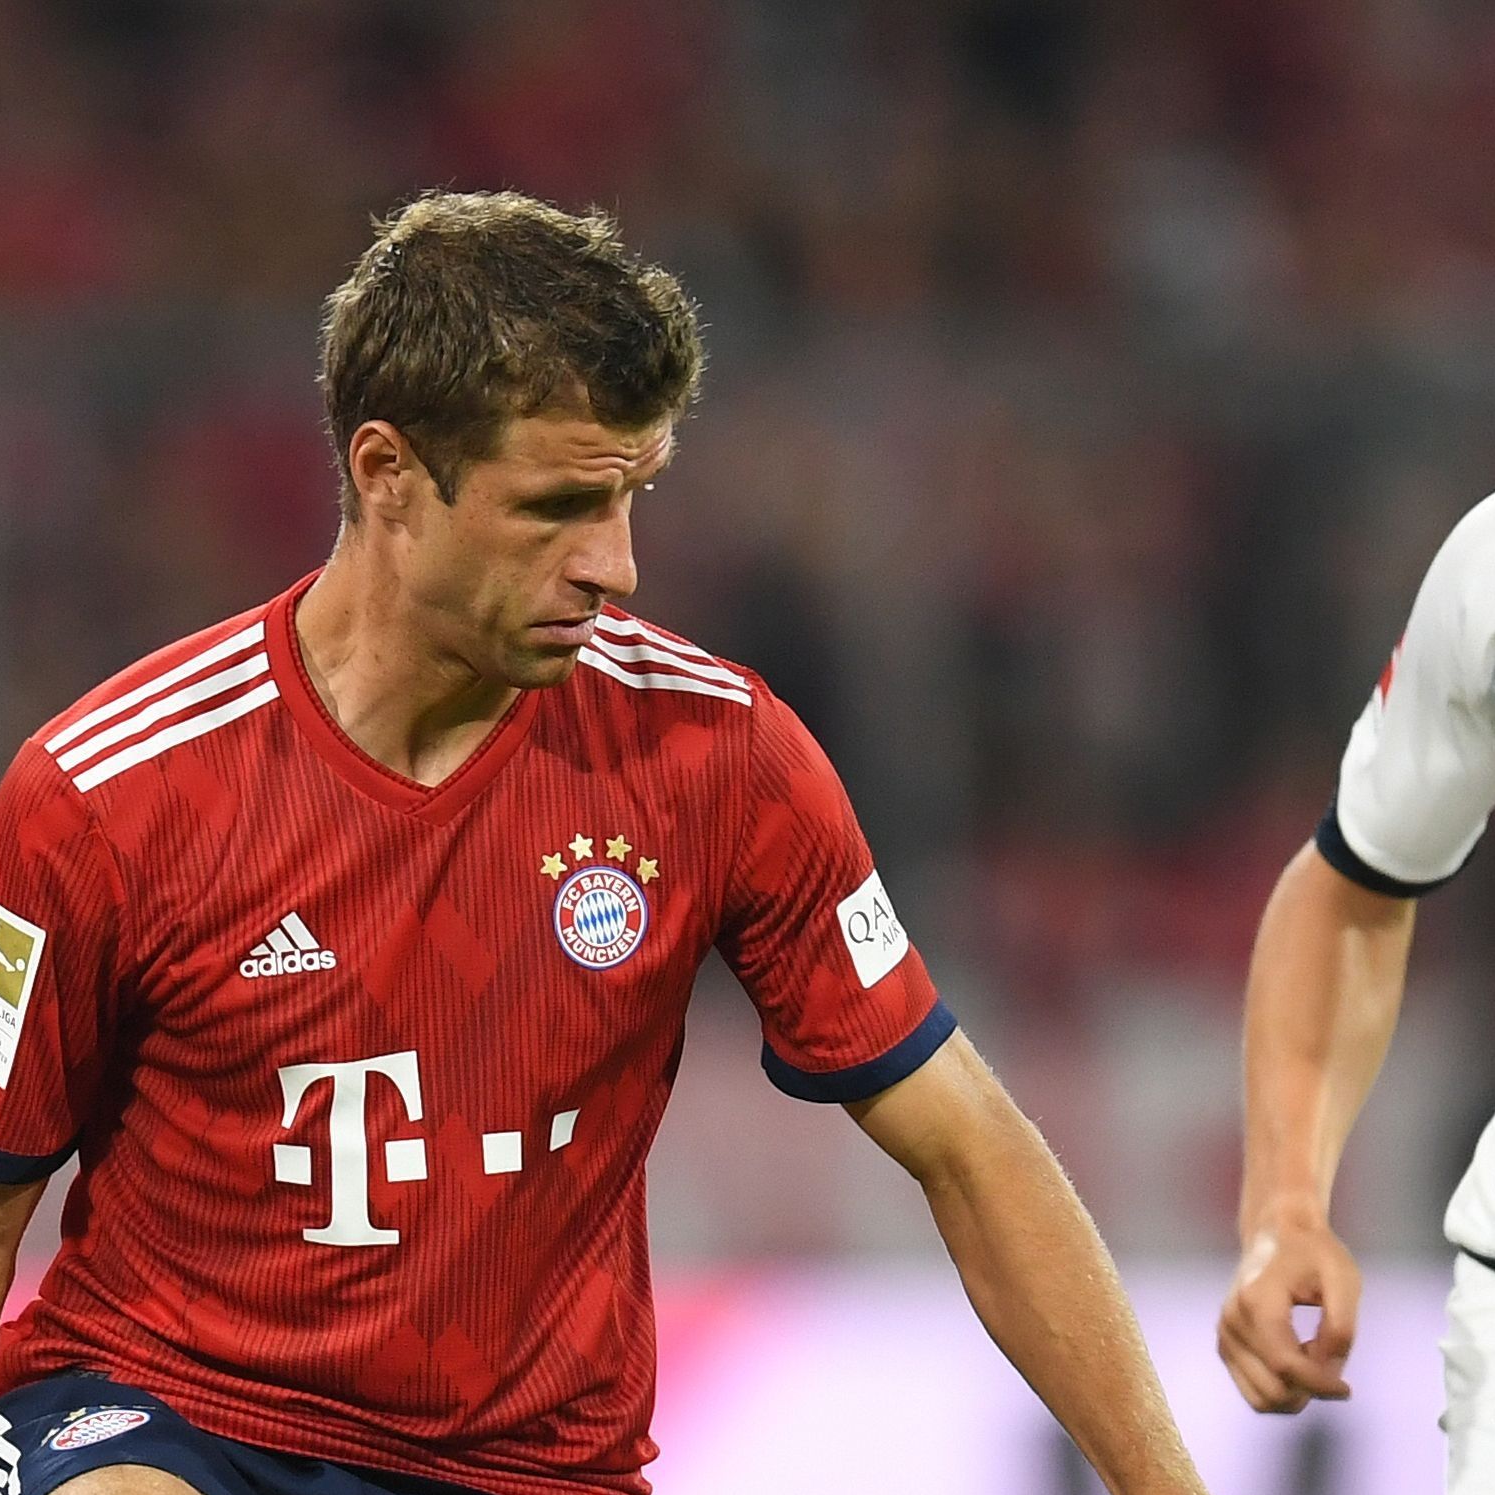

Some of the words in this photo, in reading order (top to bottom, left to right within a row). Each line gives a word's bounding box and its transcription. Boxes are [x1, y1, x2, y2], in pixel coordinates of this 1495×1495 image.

[562, 886, 581, 911] FC
[579, 873, 640, 913] BAYERN
[239, 948, 337, 979] adidas
